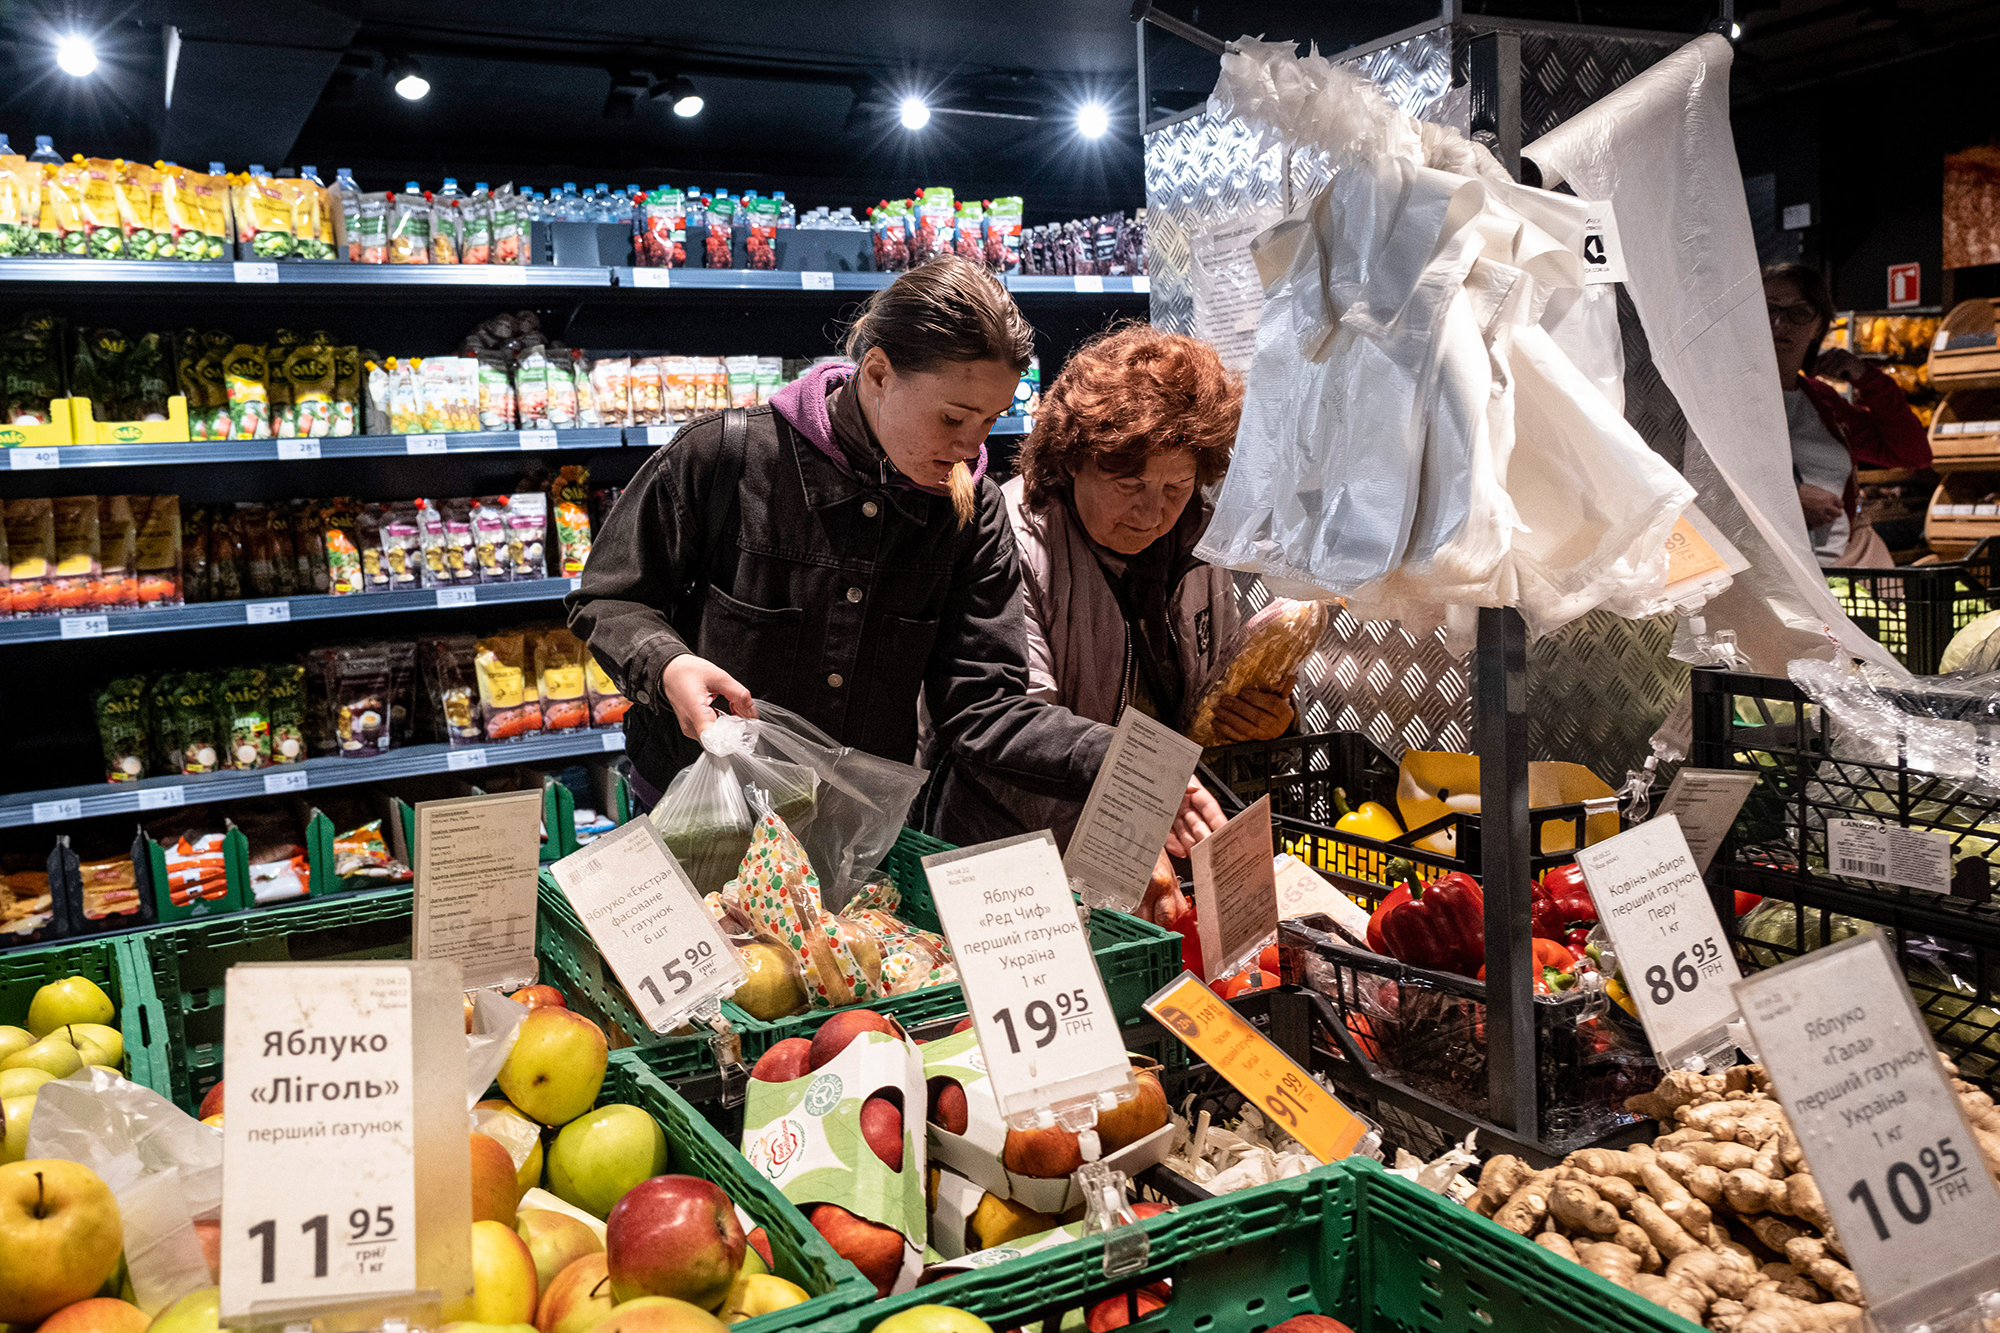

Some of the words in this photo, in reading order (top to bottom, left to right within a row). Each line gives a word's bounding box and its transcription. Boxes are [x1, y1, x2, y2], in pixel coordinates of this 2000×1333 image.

[1609, 873, 1647, 898] Корінь
[1647, 855, 1687, 881] імбиря
[585, 894, 626, 924] Яблуко
[627, 868, 673, 898] «Екстра»
[611, 892, 664, 928] фасоване
[983, 885, 1034, 905] Яблуко
[1612, 892, 1657, 919] перший
[1656, 871, 1699, 897] ґатунок
[622, 929, 630, 939] 1
[631, 905, 674, 934] ґатунок
[979, 913, 1014, 928] «Ред
[1014, 902, 1051, 921] Чиф»
[1648, 902, 1677, 922] Перу
[643, 934, 653, 945] 6
[654, 925, 669, 940] шт
[964, 931, 1022, 955] перший
[1024, 921, 1080, 942] ґатунок
[1660, 926, 1667, 937] 1
[1669, 921, 1681, 934] кг
[638, 958, 693, 1007] 15
[684, 940, 712, 966] 90
[999, 948, 1056, 970] Україна
[1645, 951, 1698, 1006] 86
[1692, 937, 1718, 964] 95
[1701, 962, 1725, 980] ГРН
[1022, 975, 1029, 988] 1
[1033, 973, 1047, 986] кг
[992, 1000, 1057, 1054] 19
[1056, 988, 1089, 1016] 95
[1065, 1017, 1093, 1036] ГРН
[1804, 1006, 1867, 1042] Яблуко
[263, 1029, 387, 1062] Яблуко
[1823, 1036, 1874, 1067] «Гала»
[250, 1075, 400, 1104] «Ліголь»
[1281, 1072, 1302, 1093] 99
[1795, 1072, 1863, 1115] перший
[1863, 1047, 1929, 1086] ґатунок
[1265, 1084, 1308, 1128] 91
[1839, 1088, 1908, 1129] Україна
[248, 1118, 327, 1144] перший
[331, 1117, 404, 1138] ґатунок
[1872, 1130, 1884, 1147] 1
[1886, 1125, 1904, 1145] кг
[1847, 1161, 1932, 1242] 10
[1918, 1136, 1961, 1180] 95
[1936, 1176, 1972, 1206] ГРН
[248, 1214, 329, 1284] 11
[349, 1206, 394, 1239] 95
[356, 1246, 386, 1261] грн/
[358, 1262, 364, 1274] 1
[370, 1261, 384, 1273] кг
